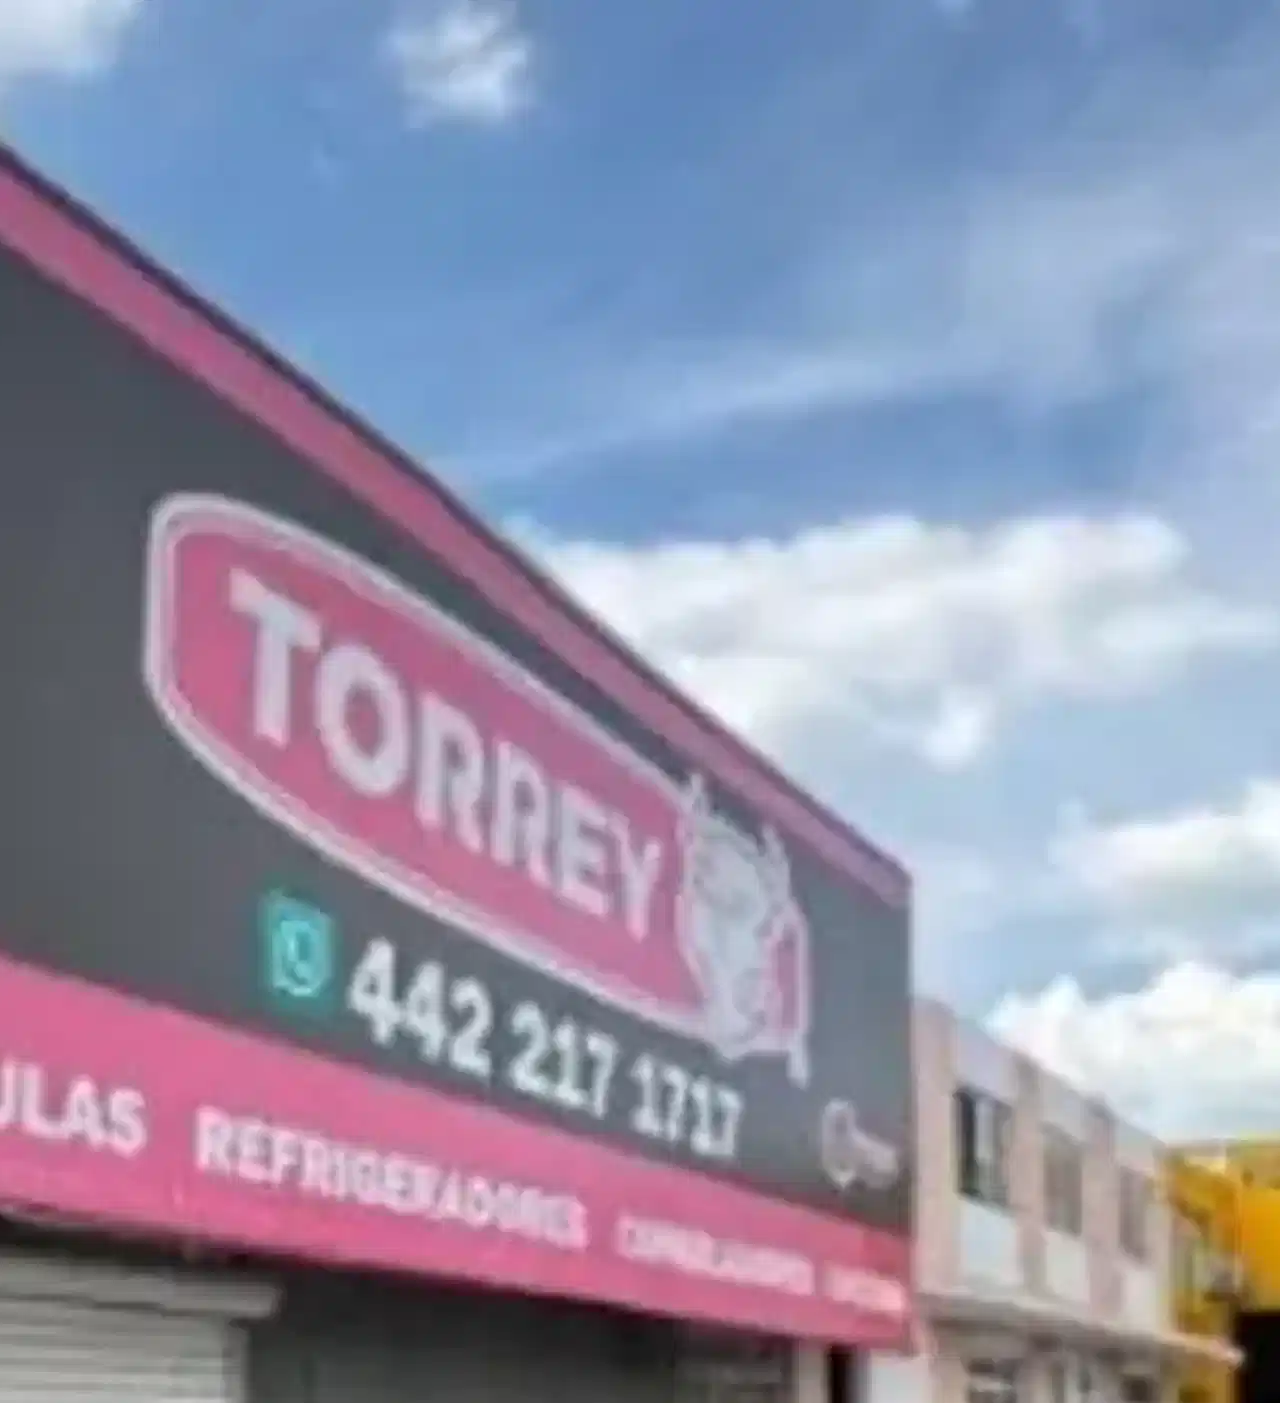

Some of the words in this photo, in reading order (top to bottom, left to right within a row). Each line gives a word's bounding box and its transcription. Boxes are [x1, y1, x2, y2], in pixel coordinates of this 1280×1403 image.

[227, 566, 662, 942] TORREY
[347, 936, 493, 1078] 442
[507, 1002, 618, 1118] 217
[628, 1051, 743, 1158] 1717
